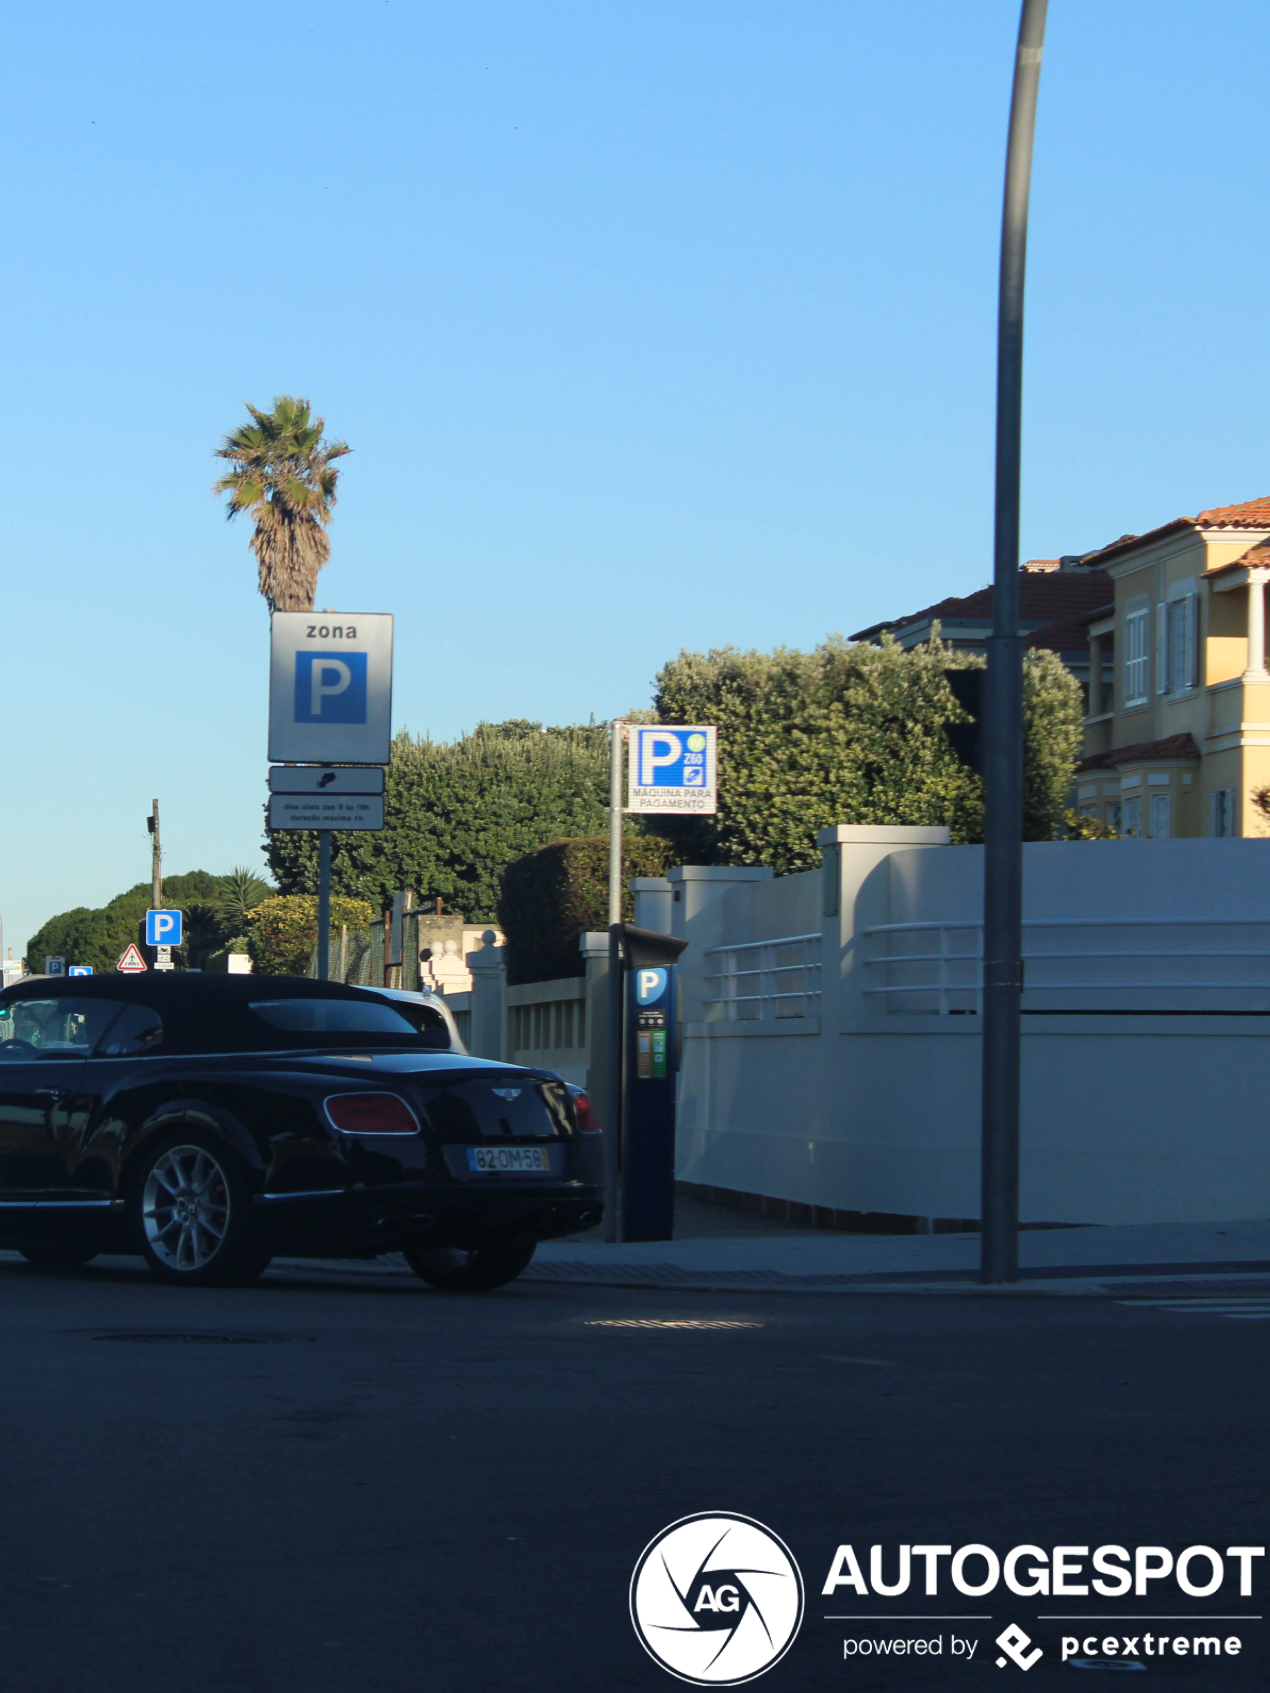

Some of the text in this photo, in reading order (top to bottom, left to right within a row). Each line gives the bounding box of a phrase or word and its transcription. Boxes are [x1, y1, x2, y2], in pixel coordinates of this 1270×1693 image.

[306, 625, 357, 639] zona
[311, 658, 351, 715] P
[642, 732, 683, 785] P
[632, 786, 711, 798] MÁQUINA PARA
[283, 803, 299, 811] dias
[301, 803, 320, 811] úteis
[322, 803, 336, 811] das
[338, 803, 344, 811] 9
[356, 803, 370, 811] 19h
[639, 799, 705, 809] PAGAMENTO
[290, 814, 320, 822] duração
[322, 814, 352, 822] máxima
[155, 914, 174, 941] P
[641, 971, 659, 998] P
